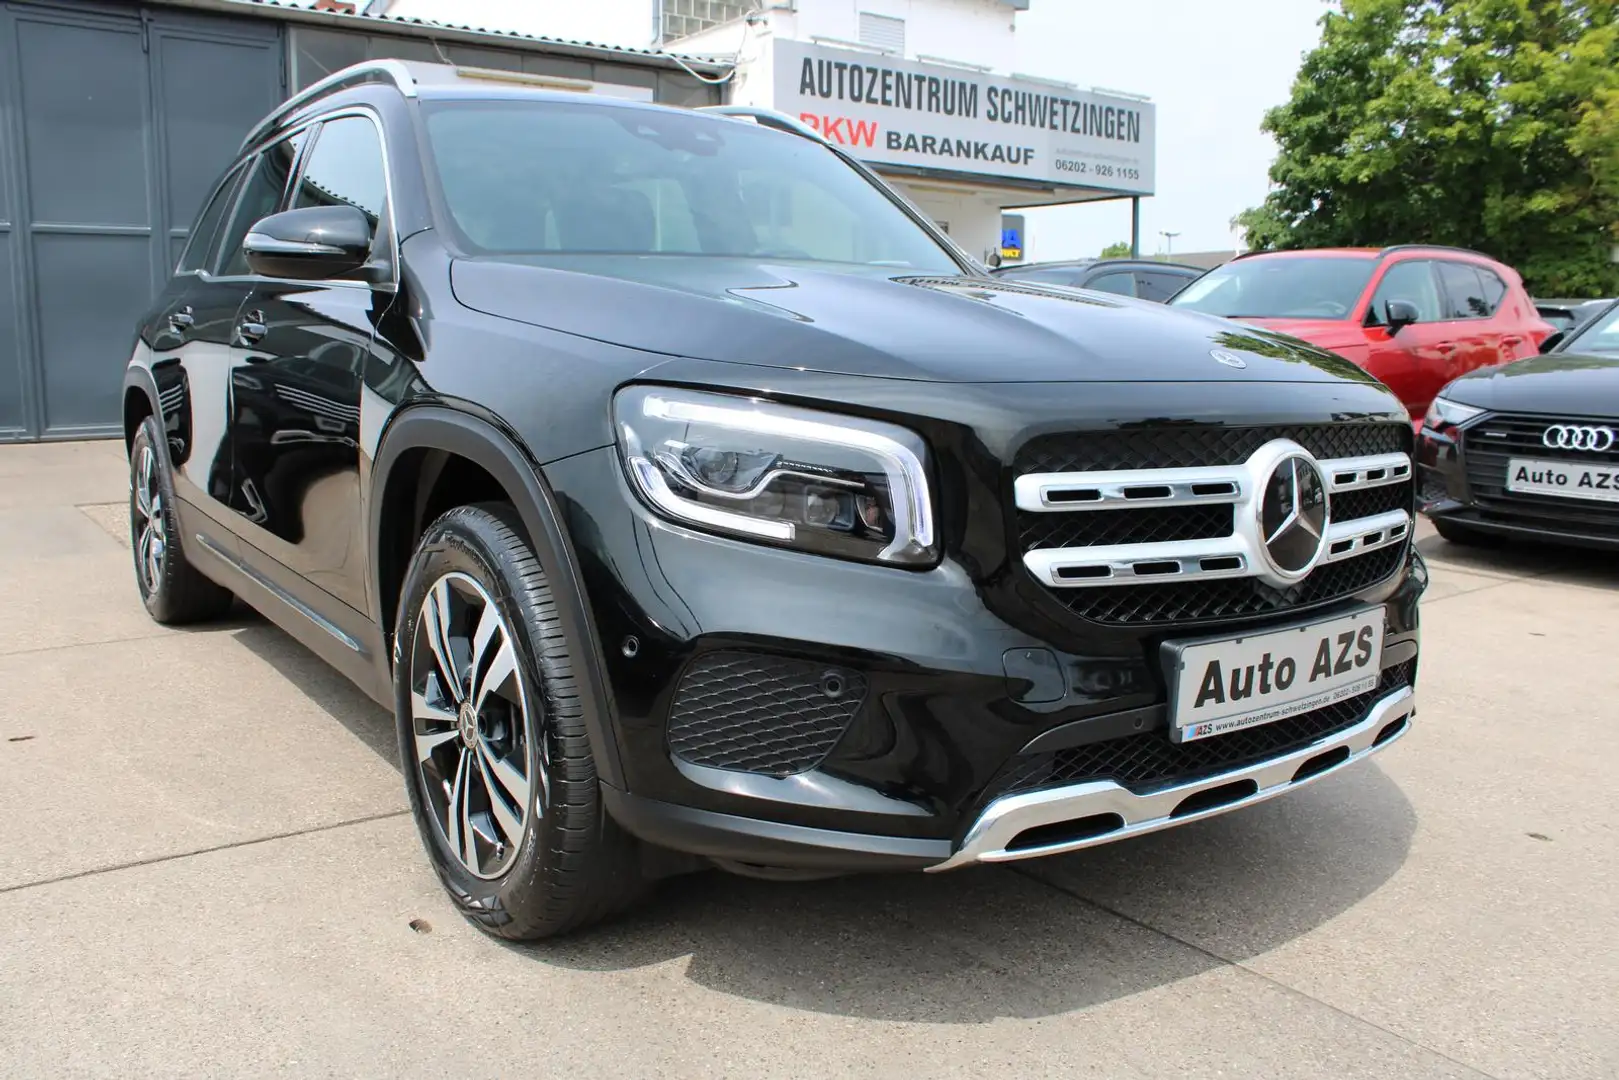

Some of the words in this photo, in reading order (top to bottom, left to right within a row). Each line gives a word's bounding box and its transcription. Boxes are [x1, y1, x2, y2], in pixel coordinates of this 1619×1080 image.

[799, 57, 979, 119] AUTOZENTRUM
[986, 86, 1141, 144] SCHWETZINGEN
[886, 130, 1035, 166] BARANKAUF
[1055, 159, 1086, 173] 06202
[1095, 164, 1114, 177] 926
[1116, 167, 1140, 180] 1155
[1515, 466, 1568, 486] Auto
[1193, 652, 1296, 708] Auto
[1308, 624, 1374, 683] AZS
[1197, 723, 1213, 736] AZS
